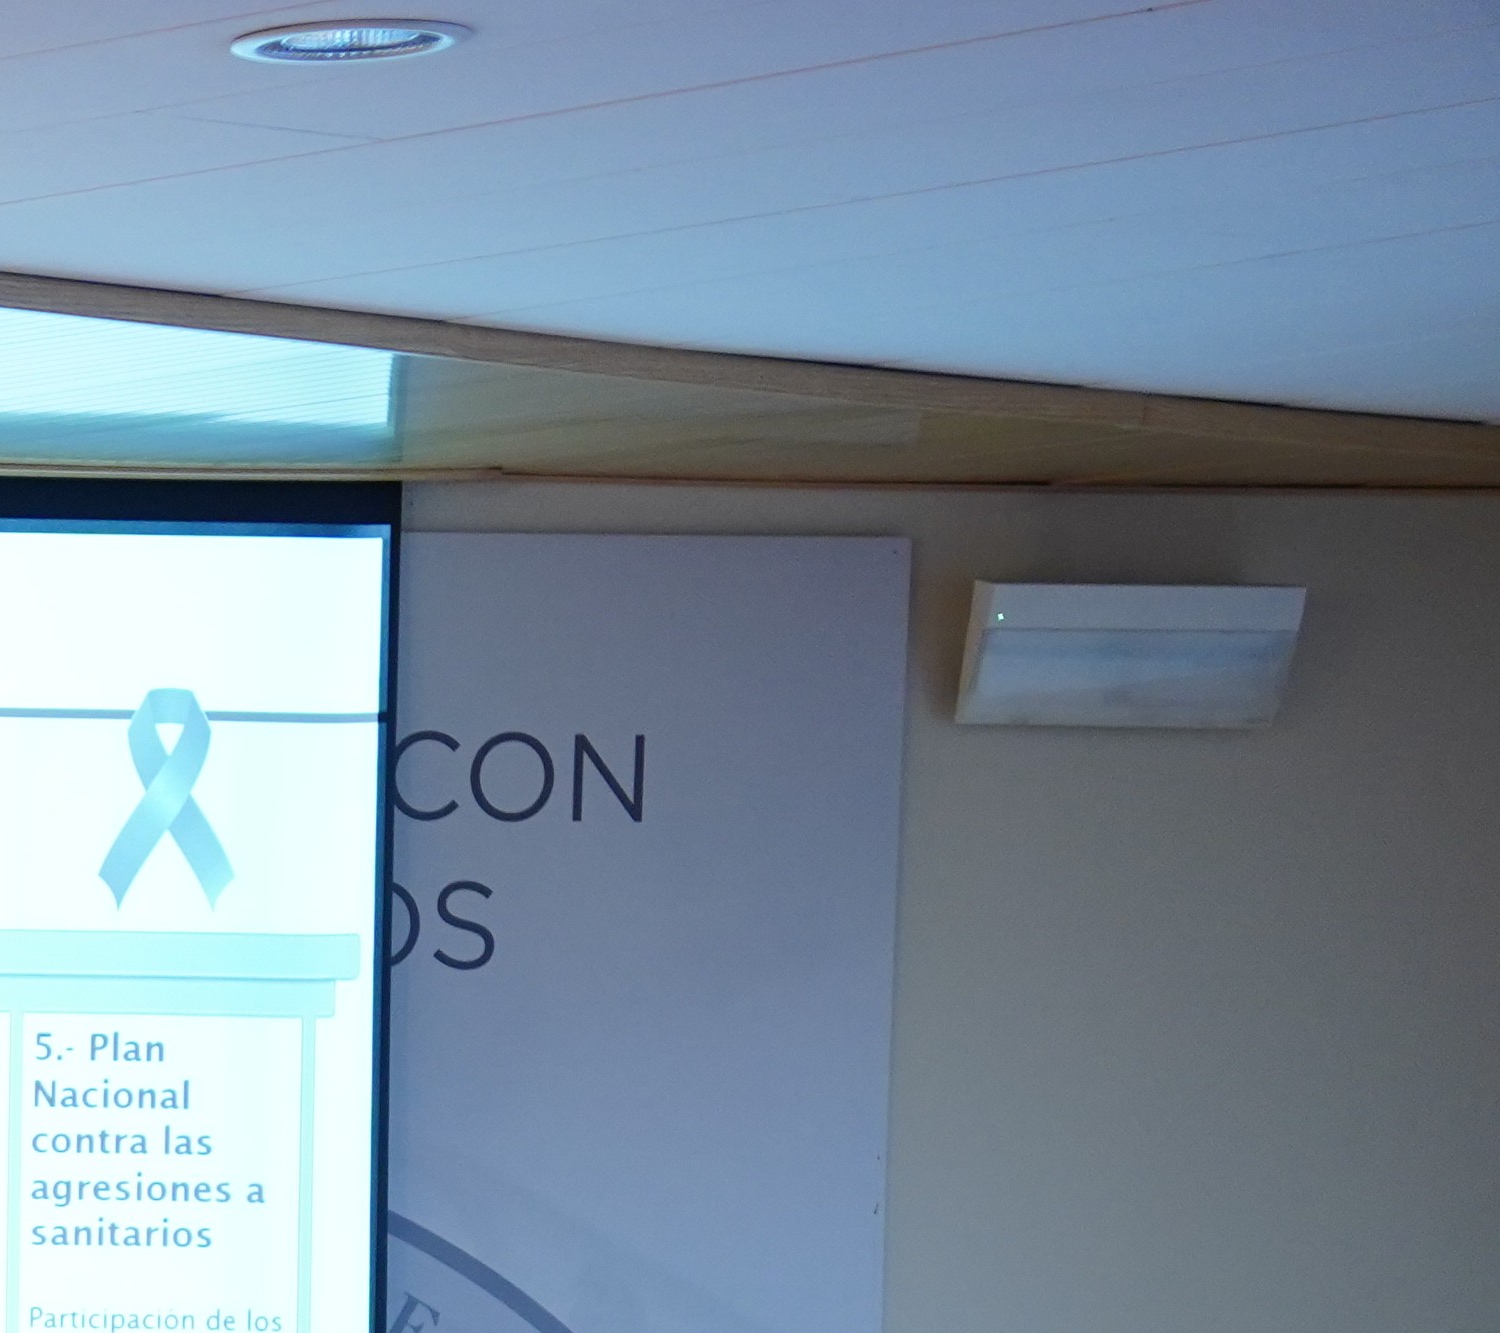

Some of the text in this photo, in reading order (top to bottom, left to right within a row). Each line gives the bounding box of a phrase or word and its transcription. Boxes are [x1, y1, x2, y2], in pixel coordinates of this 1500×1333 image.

[393, 730, 646, 823] CON
[34, 1031, 166, 1063] 5.- Plan
[32, 1078, 191, 1110] Nacional
[30, 1125, 214, 1156] contra las
[30, 1171, 266, 1207] agresiones a
[30, 1217, 214, 1248] sanitarios
[205, 1309, 237, 1333] de
[246, 1309, 284, 1333] los
